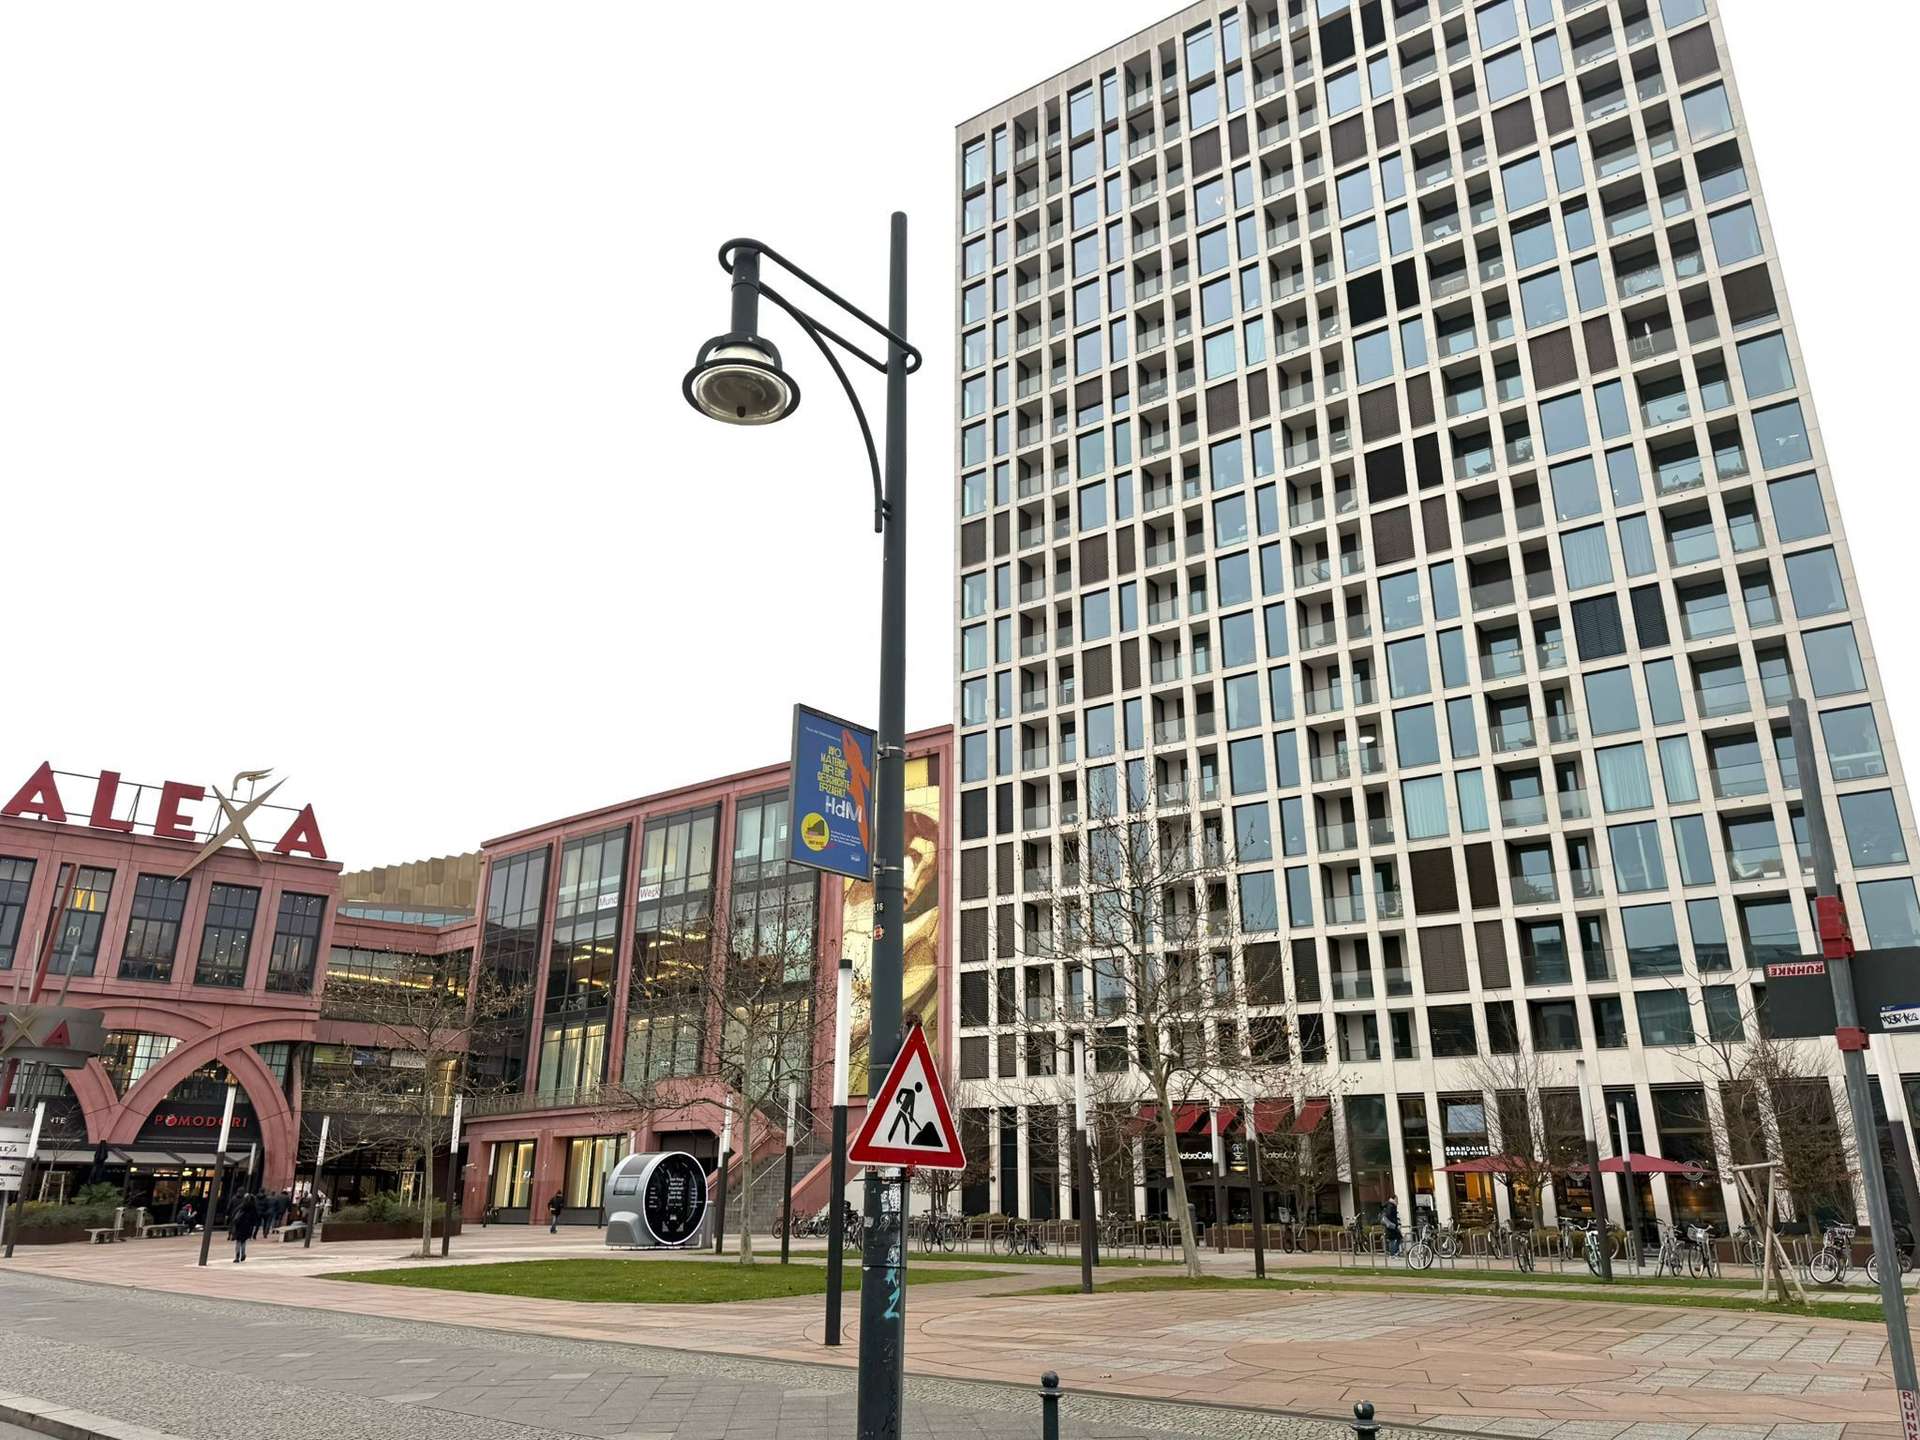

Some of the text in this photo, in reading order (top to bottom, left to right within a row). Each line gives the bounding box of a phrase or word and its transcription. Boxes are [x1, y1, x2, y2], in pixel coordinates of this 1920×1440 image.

[1, 760, 328, 880] ALEXA
[825, 795, 862, 823] HdM
[1770, 964, 1824, 976] RUHNKE
